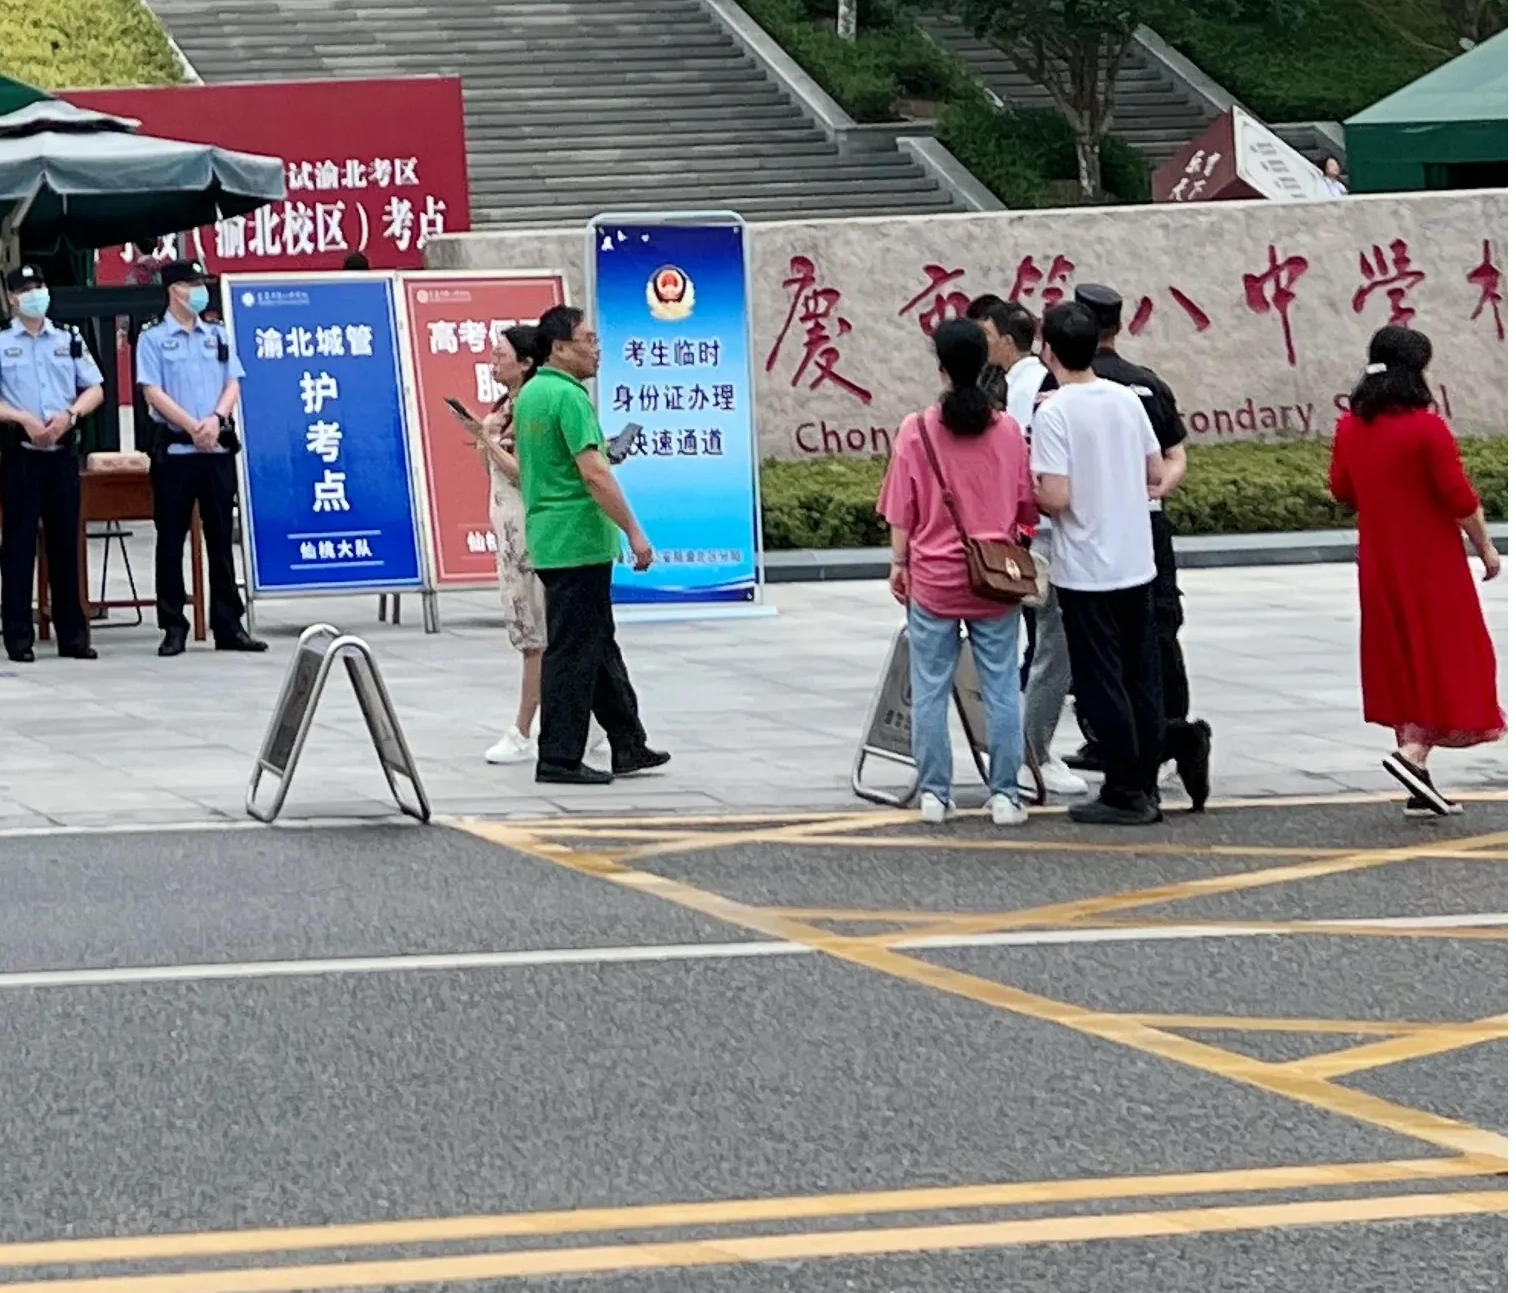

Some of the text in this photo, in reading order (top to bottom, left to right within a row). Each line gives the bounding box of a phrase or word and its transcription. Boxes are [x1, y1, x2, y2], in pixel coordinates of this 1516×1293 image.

[255, 324, 373, 359] 渝北城管
[624, 339, 720, 367] 考生临时
[612, 384, 736, 411] 身份证办理
[299, 538, 373, 561] 仙桃大队
